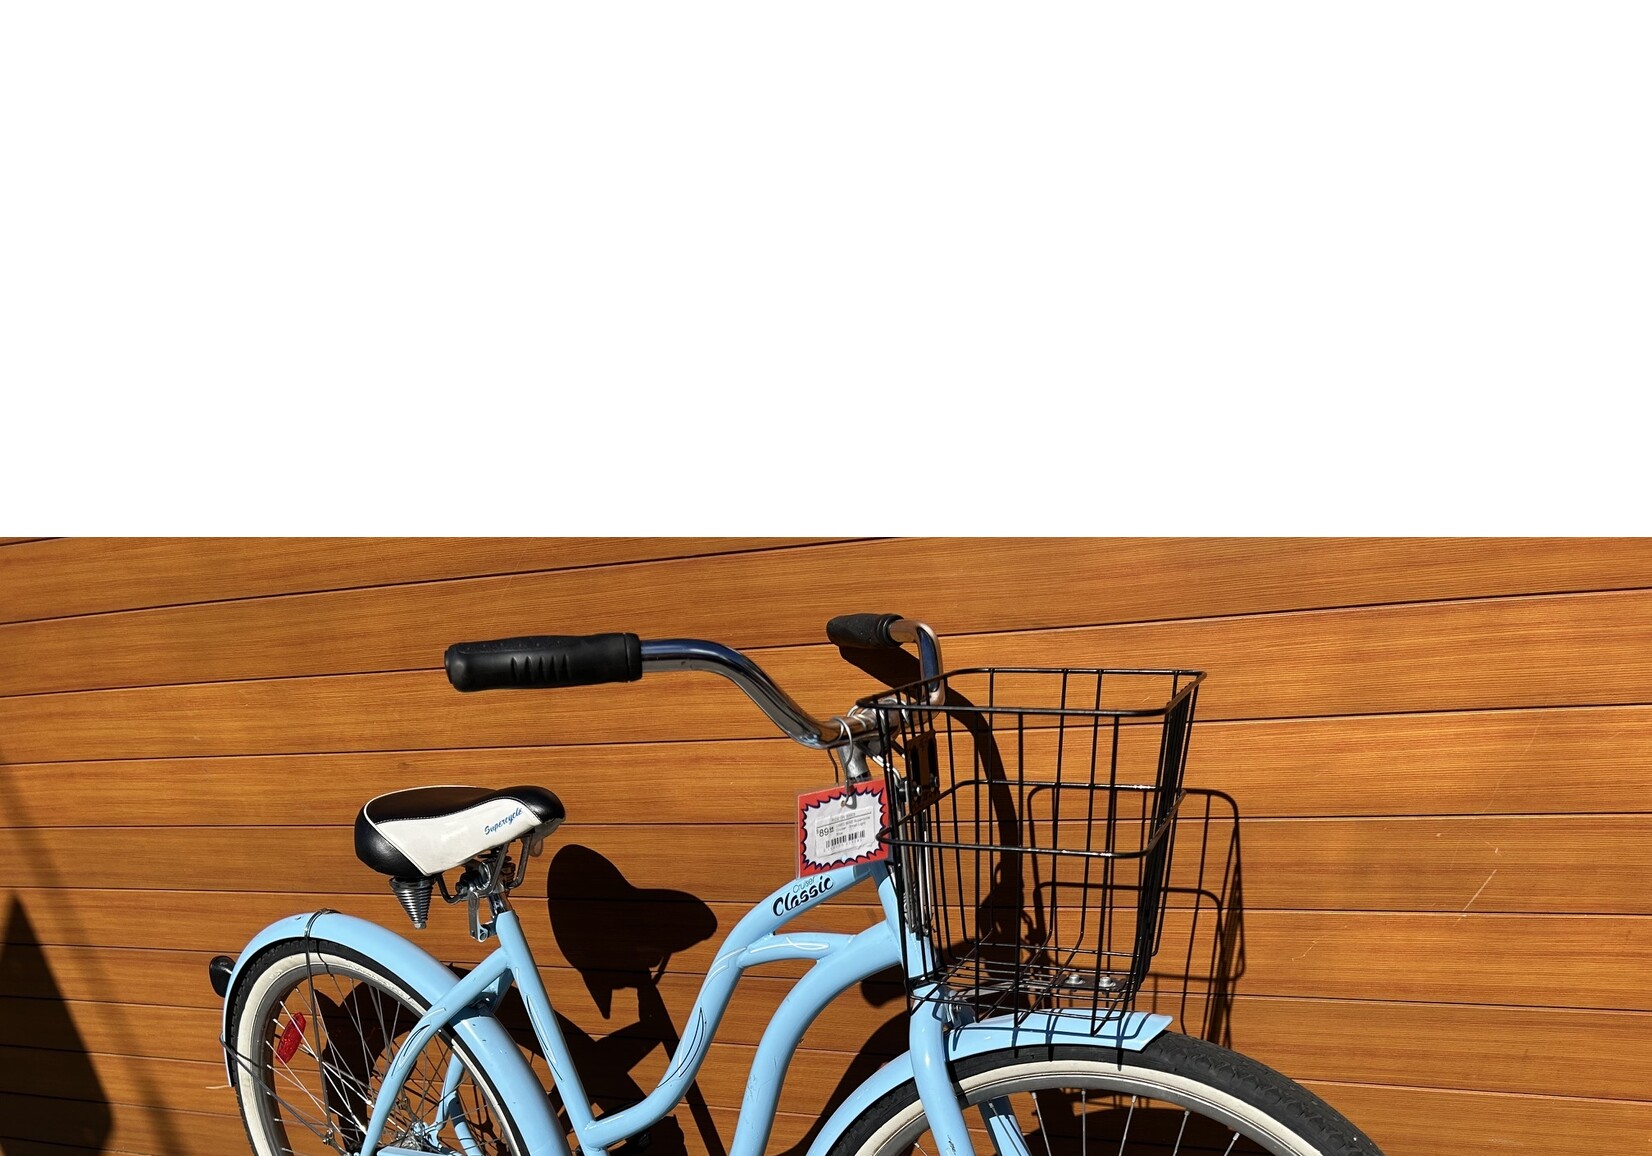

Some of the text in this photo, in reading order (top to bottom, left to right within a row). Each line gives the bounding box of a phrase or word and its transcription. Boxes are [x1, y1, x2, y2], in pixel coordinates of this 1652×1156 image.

[484, 807, 522, 835] Supercycle
[773, 875, 834, 916] Classic
[793, 876, 816, 893] Cruiser
